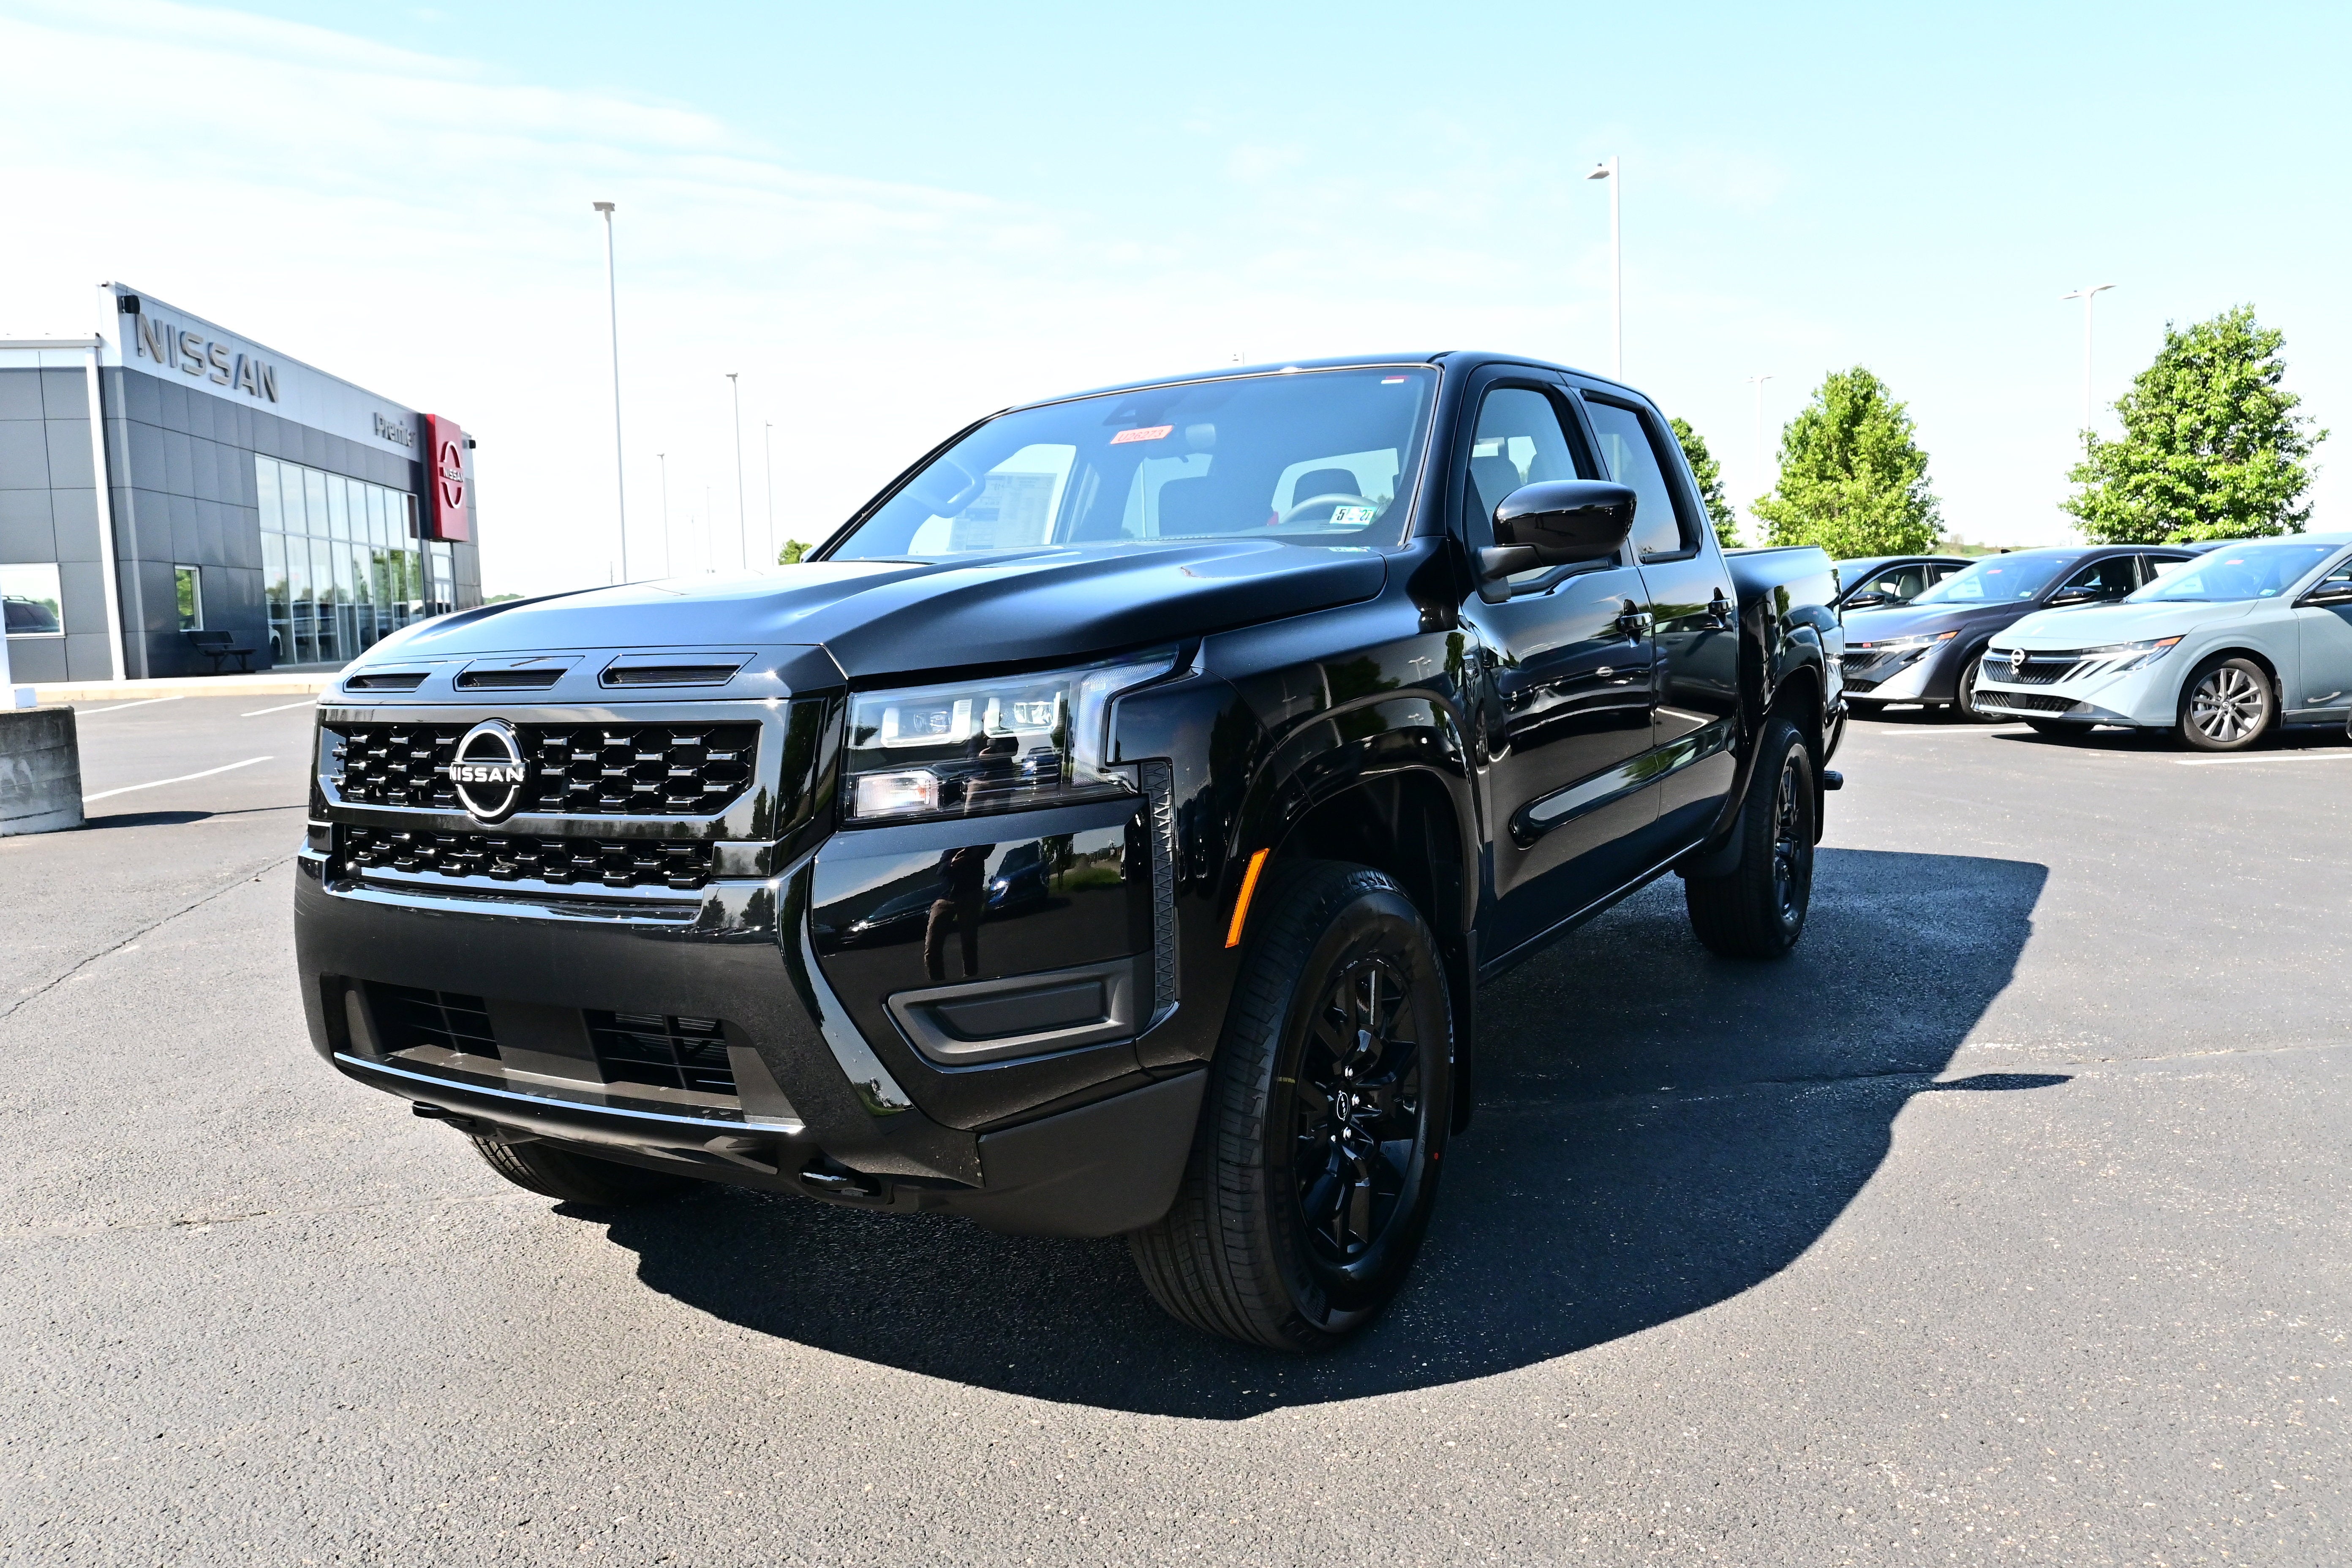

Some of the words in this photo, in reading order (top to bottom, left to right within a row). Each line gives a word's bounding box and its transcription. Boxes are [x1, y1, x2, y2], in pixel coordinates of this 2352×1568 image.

[135, 312, 277, 403] NISSAN
[374, 412, 416, 447] Premier
[1118, 429, 1163, 441] U26273
[443, 467, 463, 482] NISSAN
[1337, 509, 1347, 520] 5
[1360, 509, 1372, 521] 27
[449, 766, 524, 782] NISSAN
